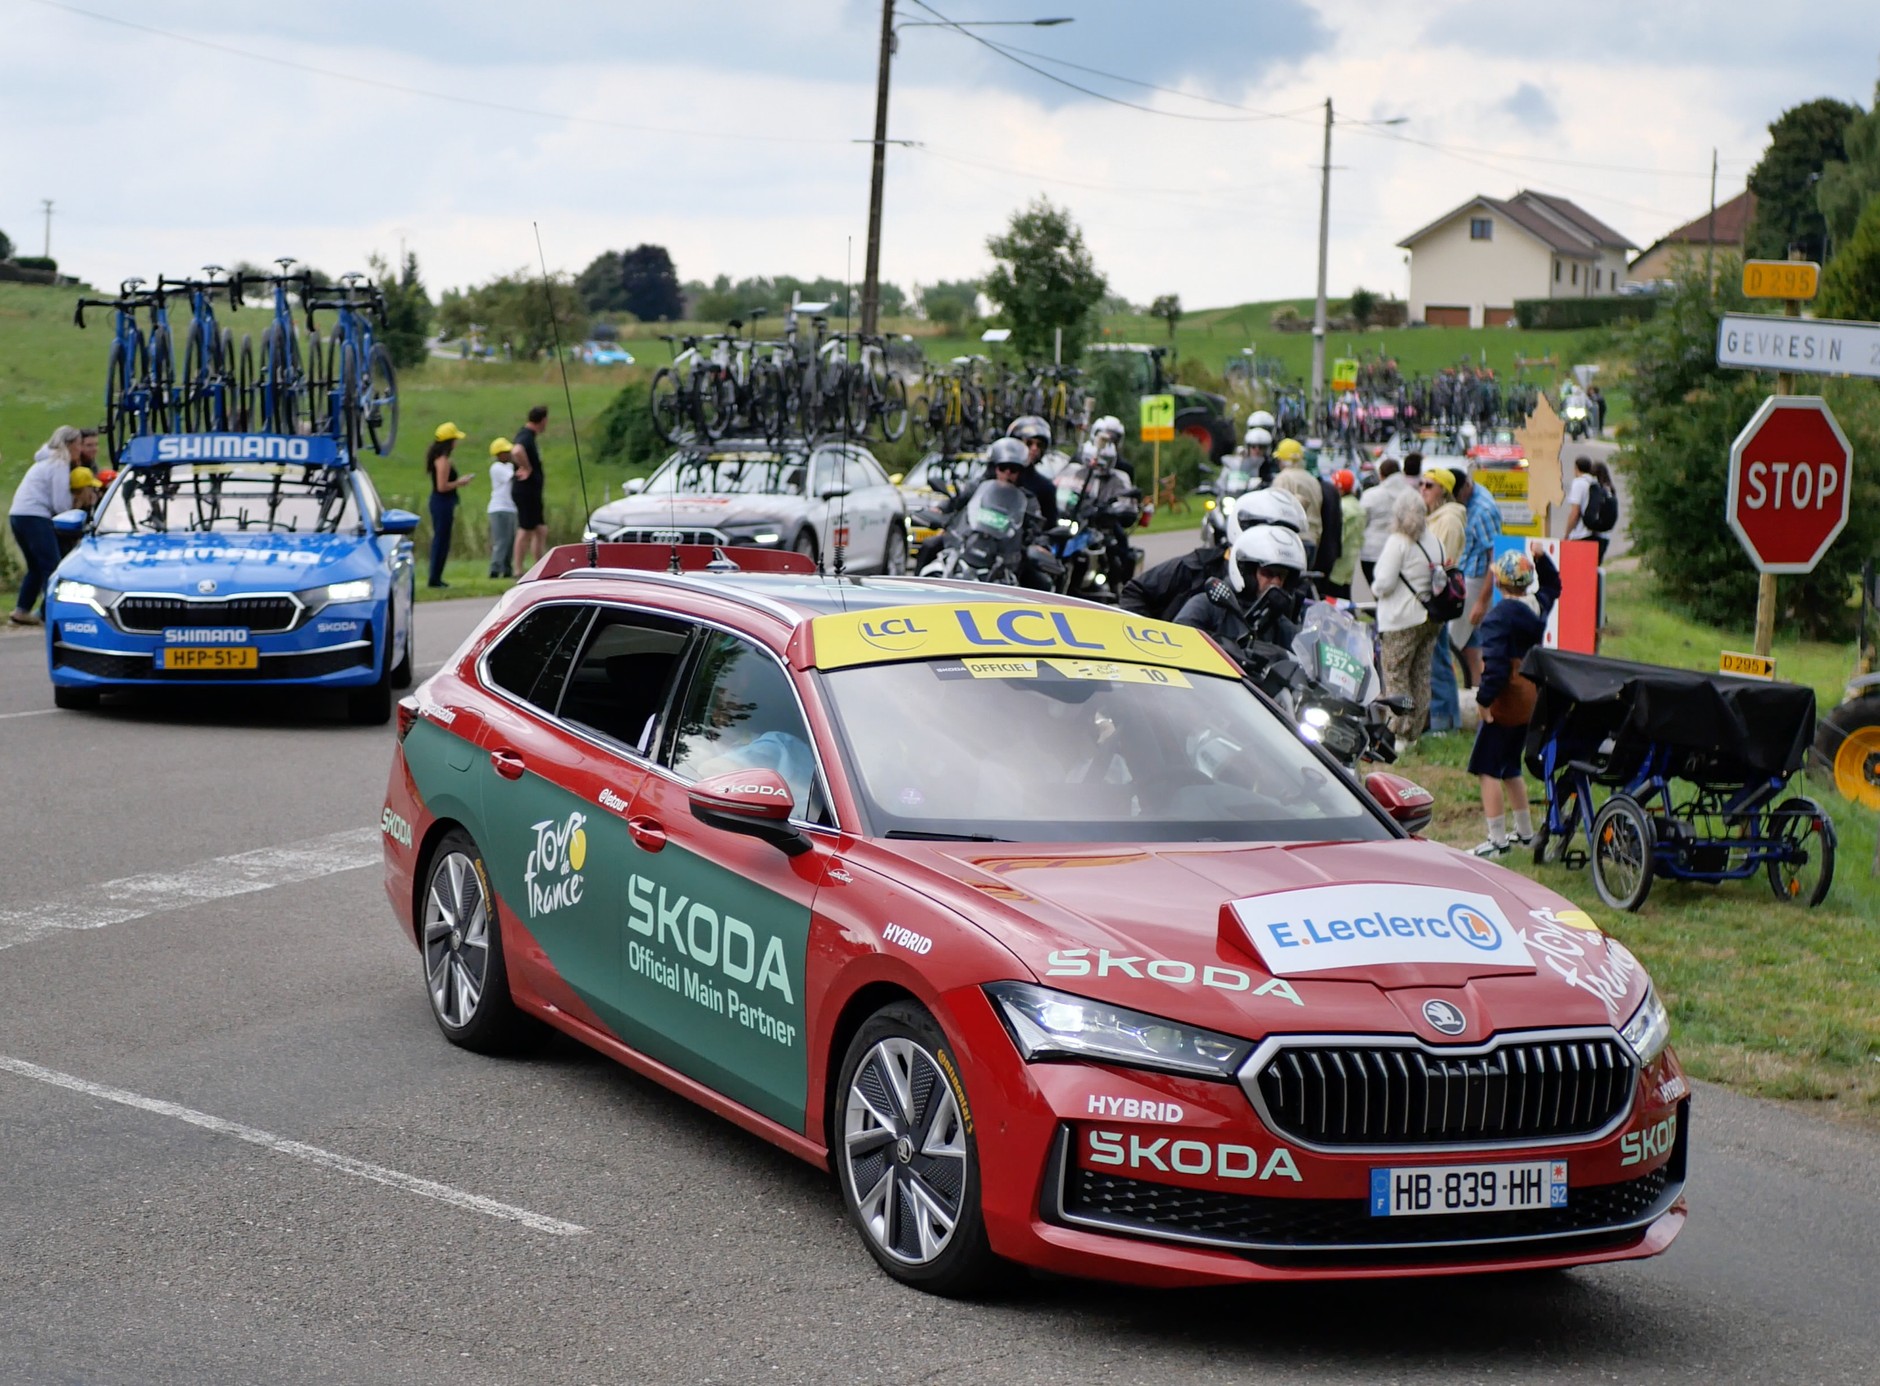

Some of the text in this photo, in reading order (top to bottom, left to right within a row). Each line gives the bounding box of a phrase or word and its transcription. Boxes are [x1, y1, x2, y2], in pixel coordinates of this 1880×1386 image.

[1751, 268, 1810, 293] D 295
[1727, 330, 1842, 361] GEVRESIN
[158, 437, 309, 460] SHIMANO
[1745, 460, 1838, 511] STOP
[64, 622, 98, 634] SKODA
[165, 628, 247, 643] SHIMANO
[317, 621, 357, 633] SKODA
[863, 618, 927, 638] LCL
[954, 610, 1105, 650] LCL
[1126, 625, 1183, 648] LCL
[174, 650, 247, 666] HFP-51-J
[970, 662, 1032, 673] OFFICIEL
[1325, 652, 1347, 670] 537
[1724, 655, 1759, 674] D 295
[1140, 668, 1168, 683] 10
[598, 788, 628, 812] @letour
[716, 784, 788, 798] SKODA
[380, 807, 413, 849] SKODA
[627, 873, 794, 1005] SKODA
[882, 922, 933, 955] HYBRID
[1266, 911, 1451, 949] E.Leclerc
[1045, 948, 1305, 1007] SKODA
[629, 940, 796, 1047] Official Main Partner
[937, 1048, 970, 1129] Continental
[1088, 1094, 1184, 1123] HYBRID
[1620, 1114, 1676, 1167] SKOD
[1089, 1129, 1303, 1182] SKODA
[1395, 1168, 1543, 1211] HB-839-HH
[1551, 1185, 1568, 1204] 92
[1377, 1198, 1385, 1210] F
